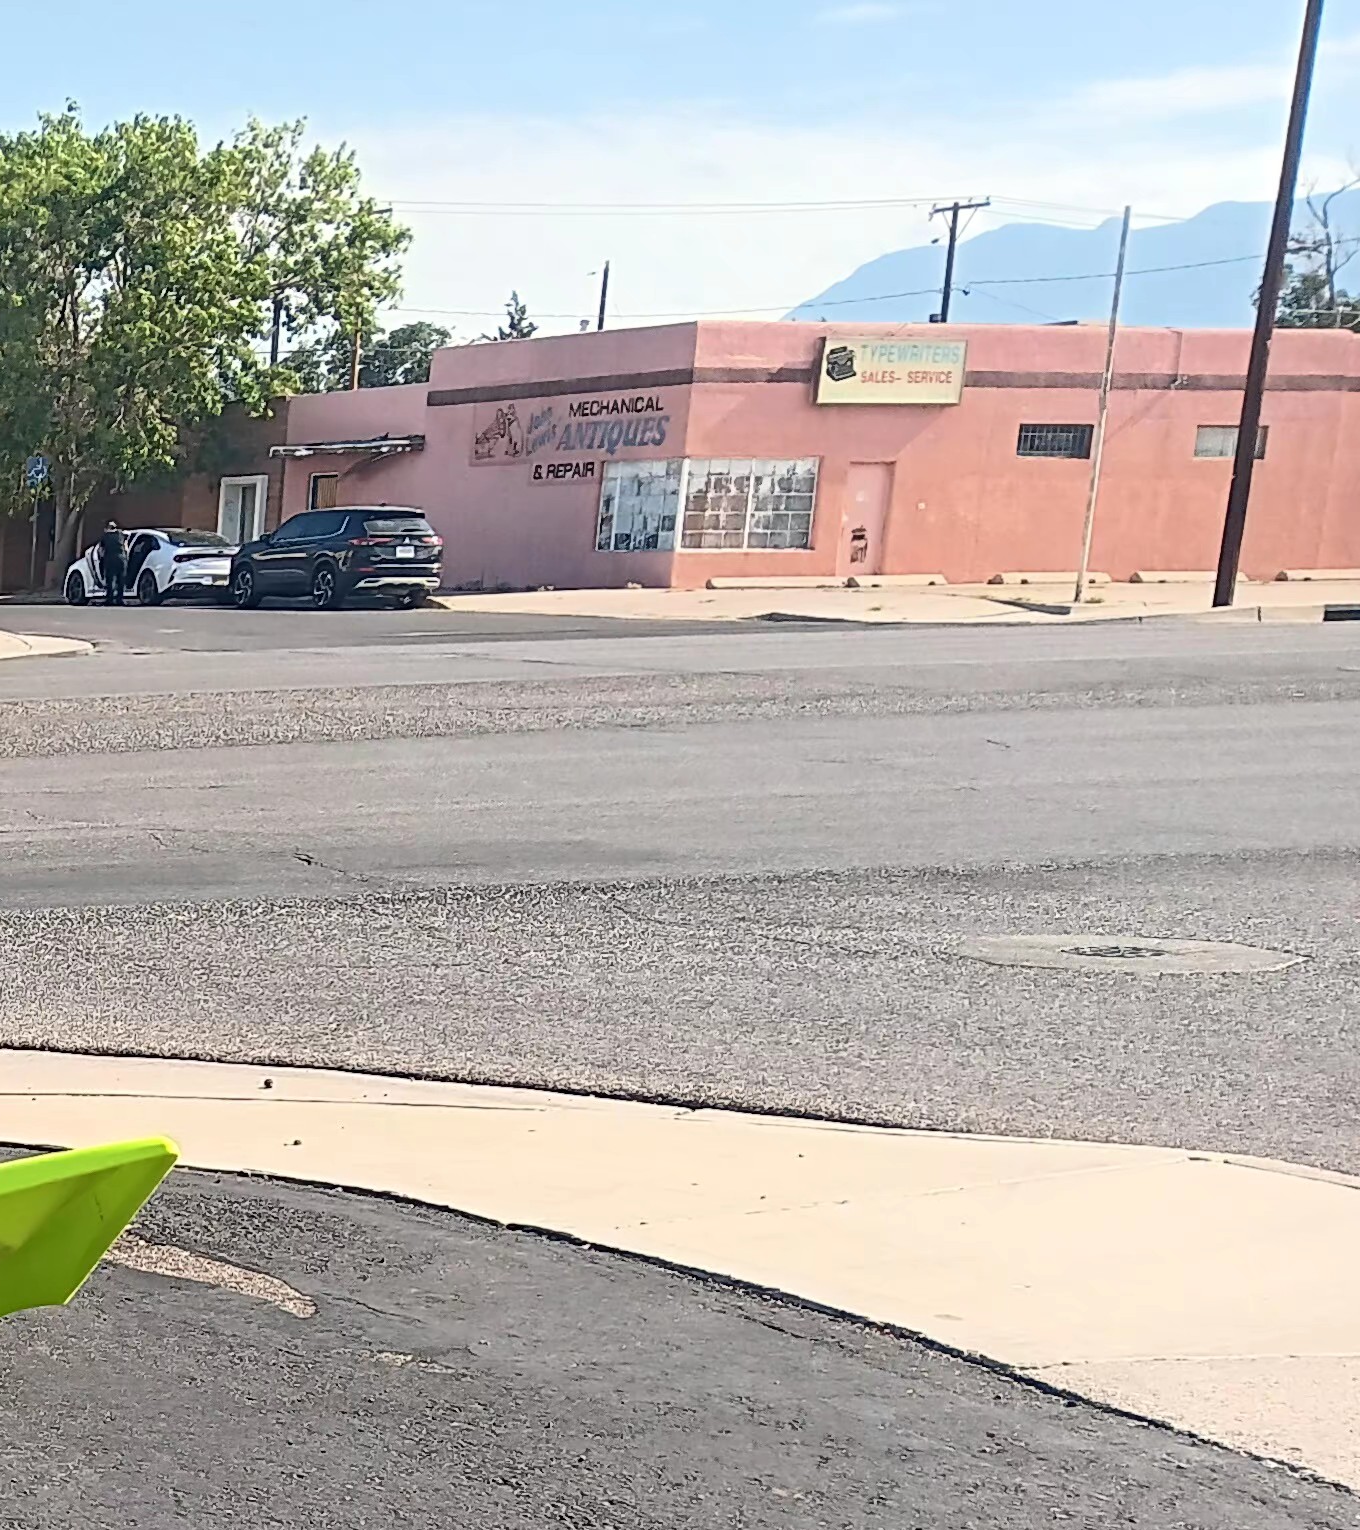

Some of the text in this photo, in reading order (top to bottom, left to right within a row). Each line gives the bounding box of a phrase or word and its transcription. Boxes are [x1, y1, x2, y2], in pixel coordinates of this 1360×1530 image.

[861, 344, 960, 363] TYPEWRITERS
[907, 370, 953, 384] SERVICE
[568, 396, 665, 418] MECHANICAL
[556, 415, 671, 456] ANTIQUES
[533, 461, 595, 480] & REPAIR
